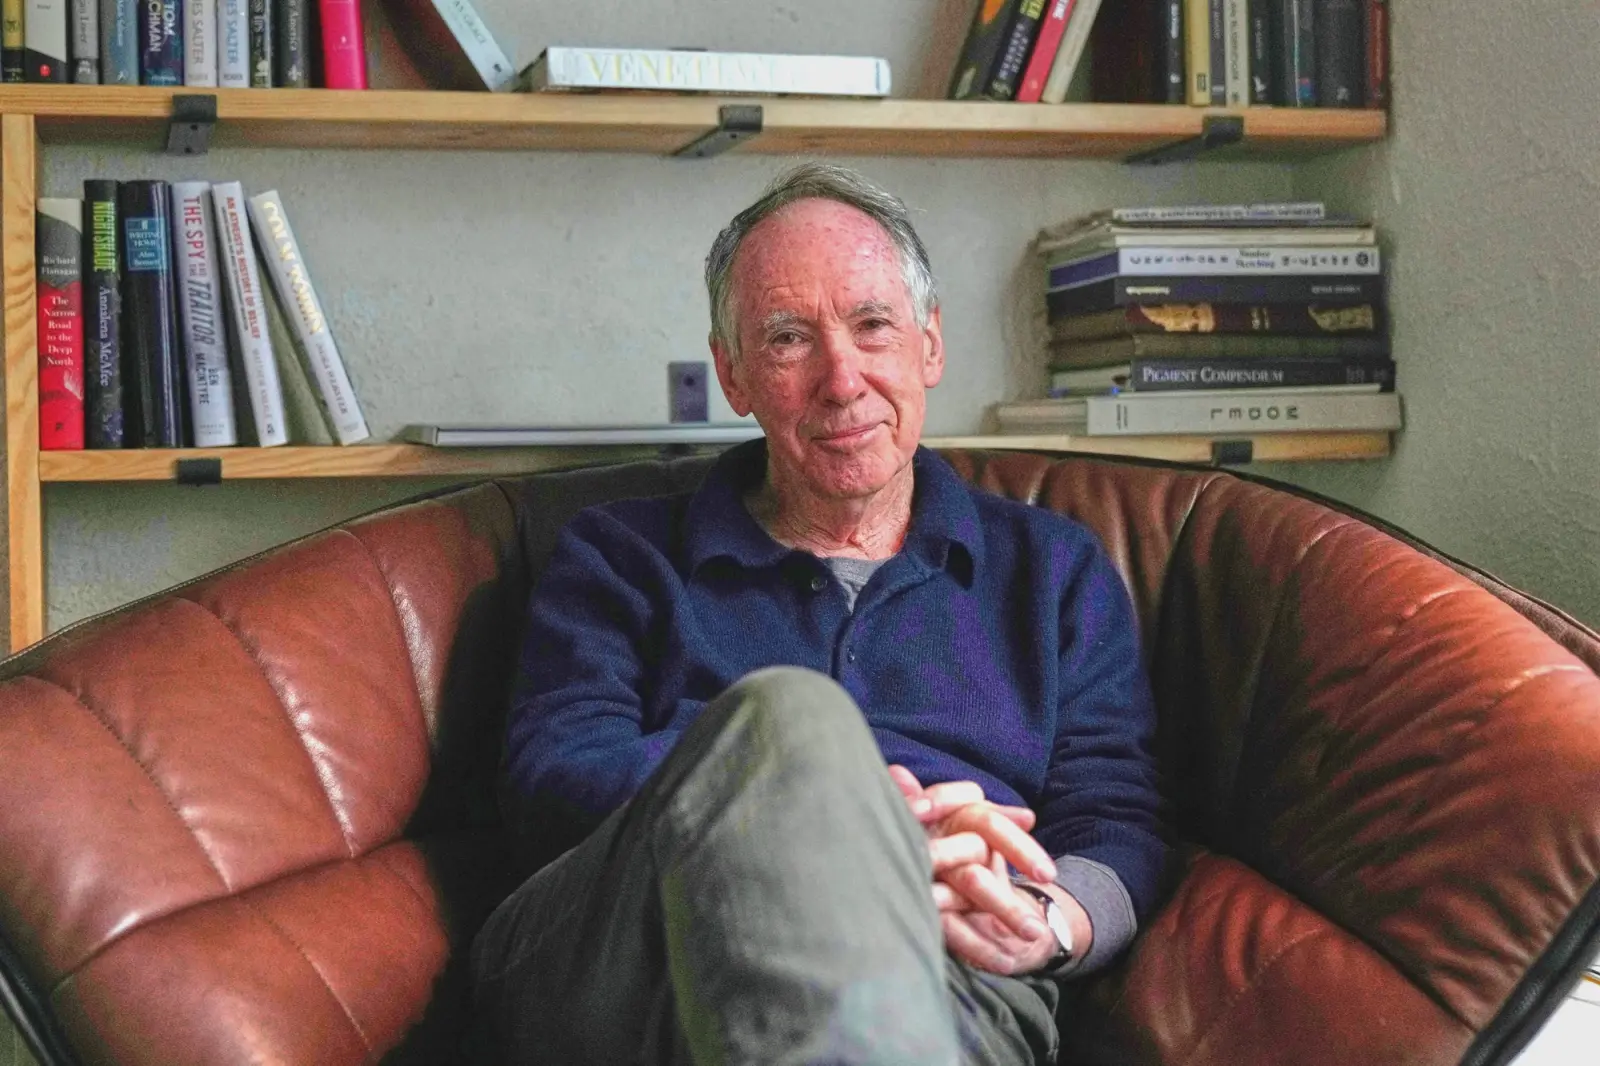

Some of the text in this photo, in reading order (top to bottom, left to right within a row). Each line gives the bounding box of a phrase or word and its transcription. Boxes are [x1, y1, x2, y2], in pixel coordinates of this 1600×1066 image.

[148, 0, 161, 52] CHMAN
[163, 1, 176, 35] TOM
[192, 0, 204, 64] ES SALTER
[226, 0, 238, 64] ES SALTER
[184, 196, 205, 259] THE SPY
[93, 202, 115, 272] NIGHTSHADE
[43, 256, 76, 264] Richard
[226, 197, 260, 338] AN ATHEIST'S HISTORY OF BELIEF
[41, 267, 78, 275] Flanagan
[51, 296, 69, 305] The
[44, 308, 76, 317] Narrow
[187, 280, 215, 345] TRAITOR
[48, 321, 72, 329] Road
[47, 333, 72, 341] to the
[100, 286, 113, 387] Annalena McAfee
[48, 345, 72, 355] Deep
[47, 357, 73, 366] North
[196, 352, 210, 405] MACINTYRE
[208, 368, 220, 386] BEN
[1143, 366, 1285, 383] PIGMENT COMPENDIUM
[1210, 407, 1299, 421] MODEL
